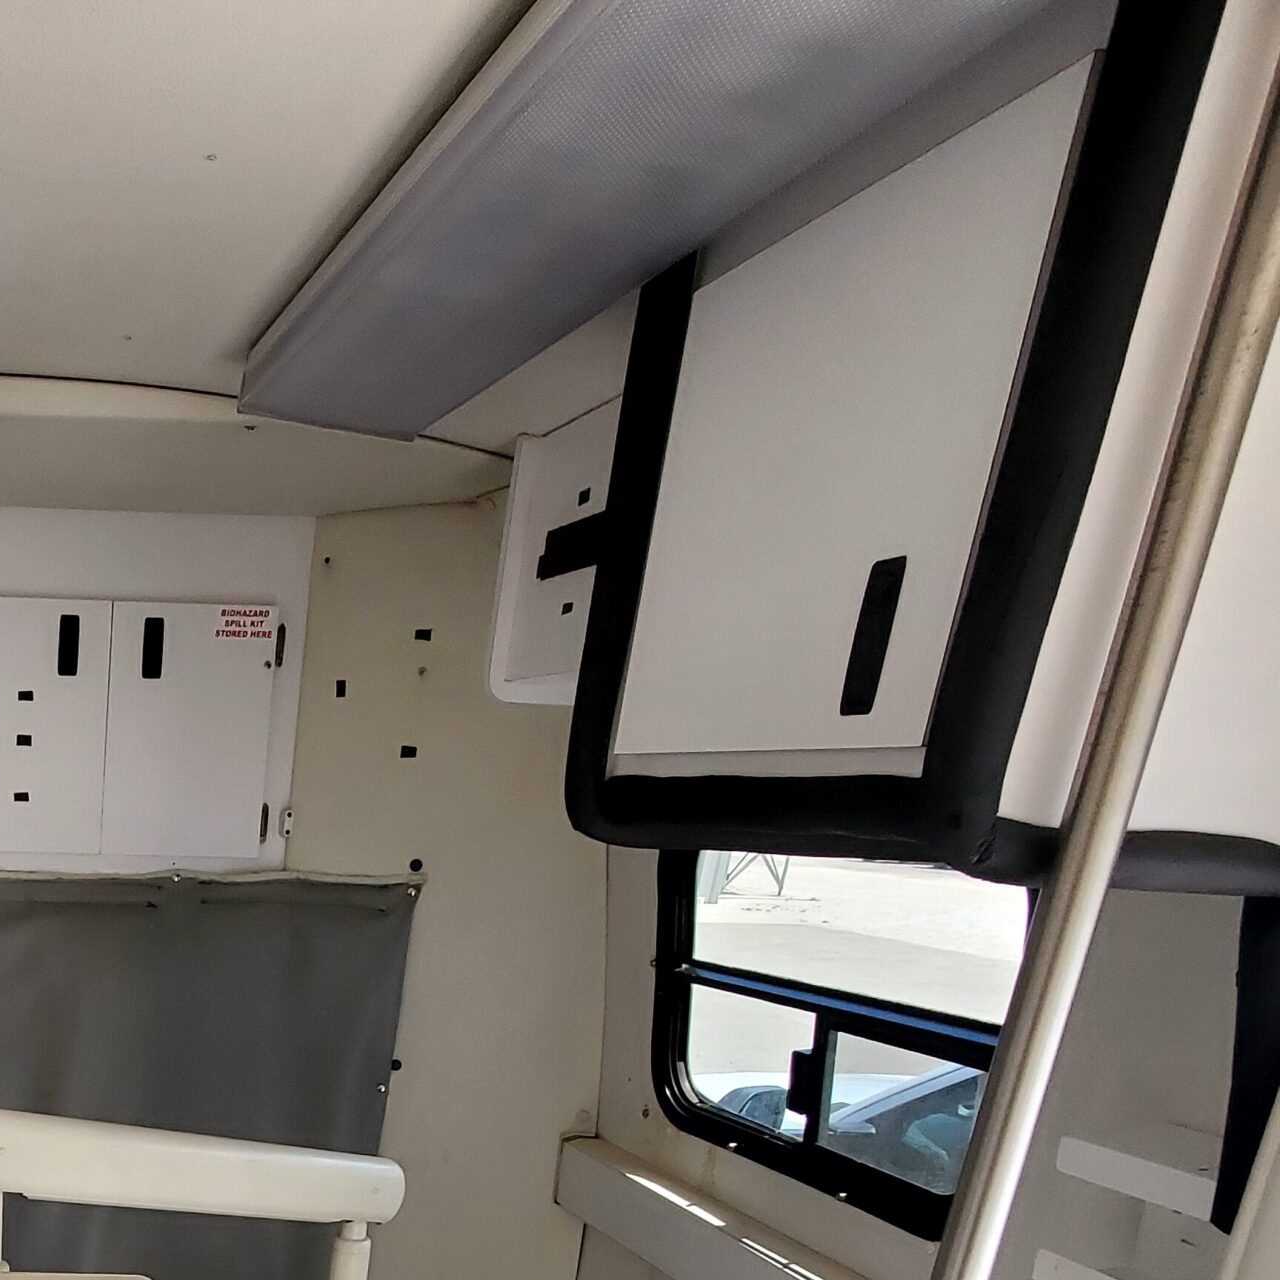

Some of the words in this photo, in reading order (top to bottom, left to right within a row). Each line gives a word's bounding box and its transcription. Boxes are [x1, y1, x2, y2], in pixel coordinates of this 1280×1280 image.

[221, 609, 270, 617] BIOHAZARD
[224, 620, 247, 628] SPILL
[250, 620, 264, 628] KIT
[215, 630, 248, 638] STORED
[250, 630, 272, 638] HERE
